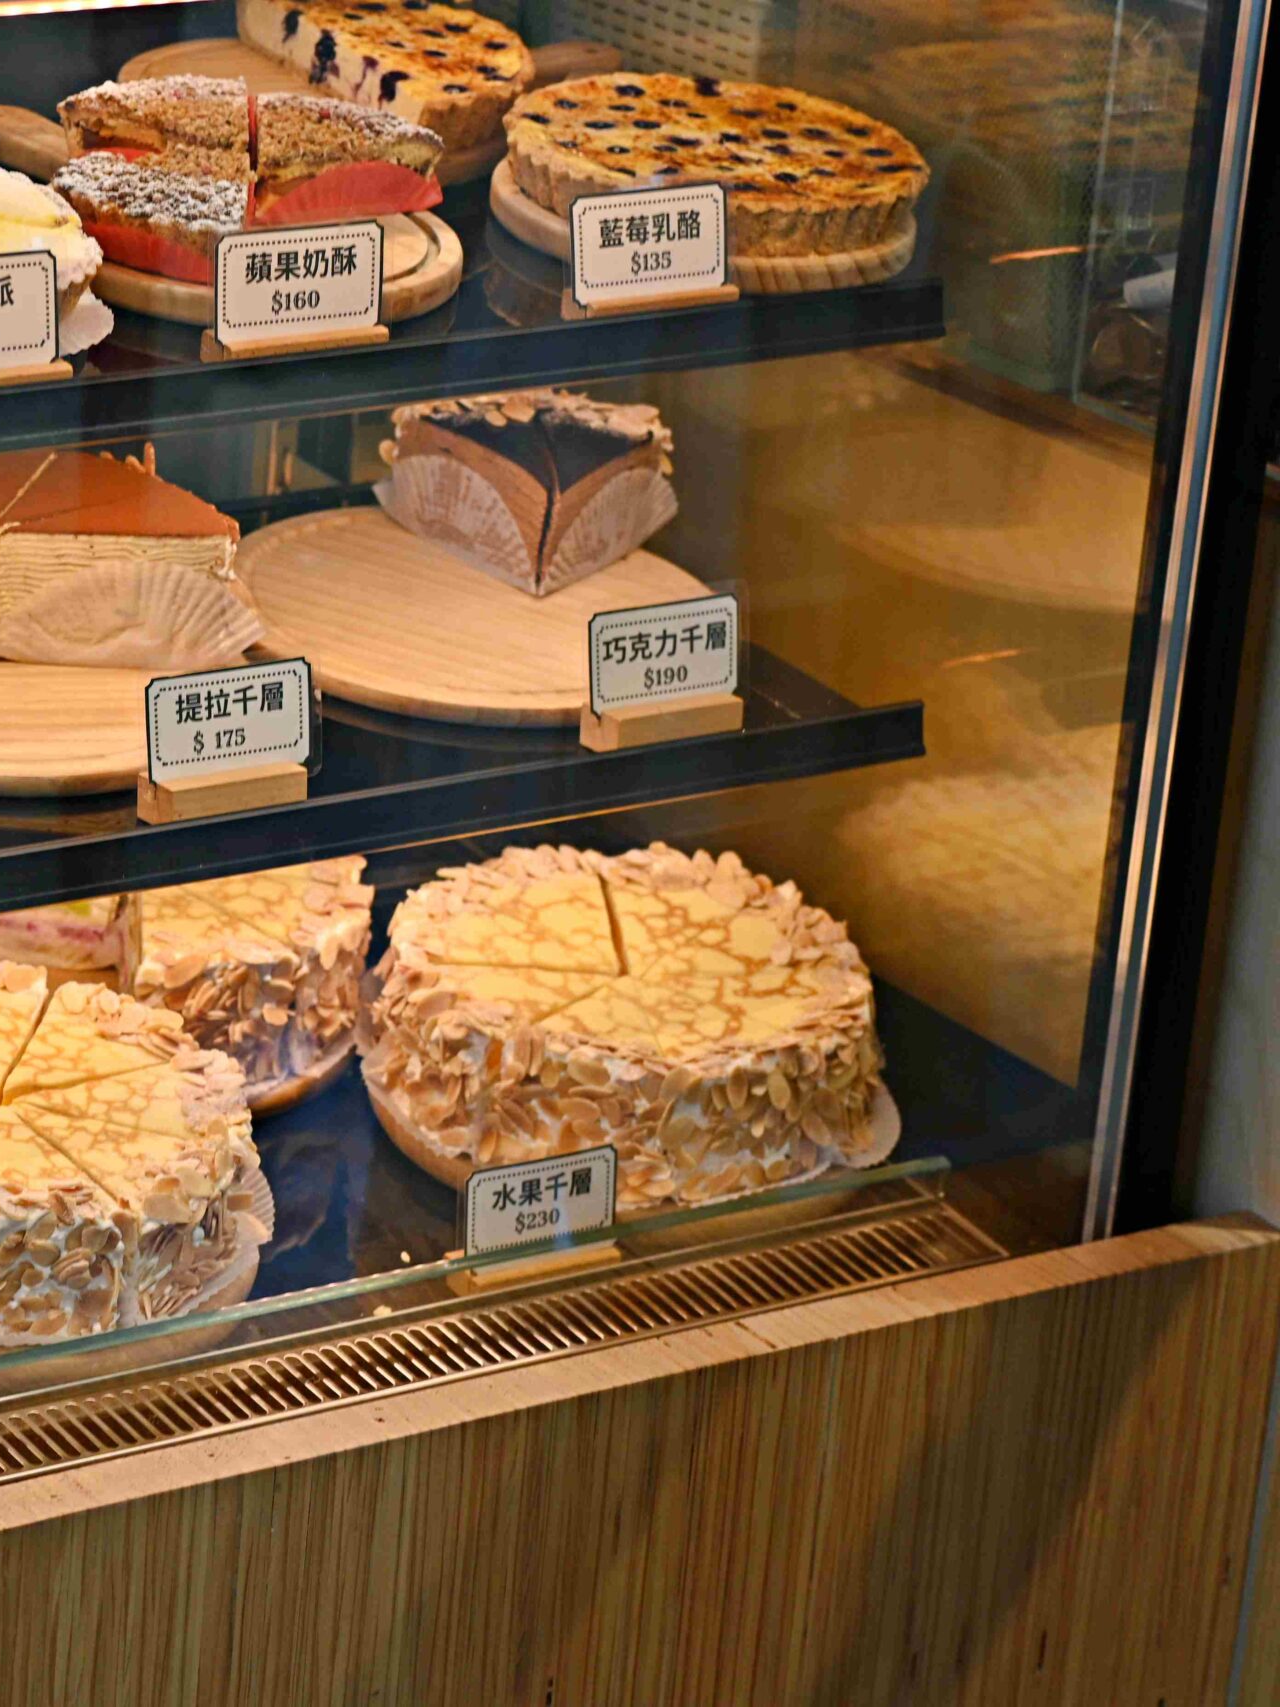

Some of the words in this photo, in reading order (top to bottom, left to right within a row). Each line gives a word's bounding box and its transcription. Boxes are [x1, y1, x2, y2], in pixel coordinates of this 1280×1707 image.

[599, 209, 701, 249] 藍莓乳酪
[245, 244, 357, 285] 蘋果奶酥
[631, 251, 672, 276] $135
[271, 289, 320, 316] $160
[602, 621, 727, 664] 巧克力千層
[643, 665, 688, 690] $190
[175, 681, 284, 724] 提拉千層
[492, 1167, 592, 1211] 水果千層
[515, 1208, 560, 1235] $230
